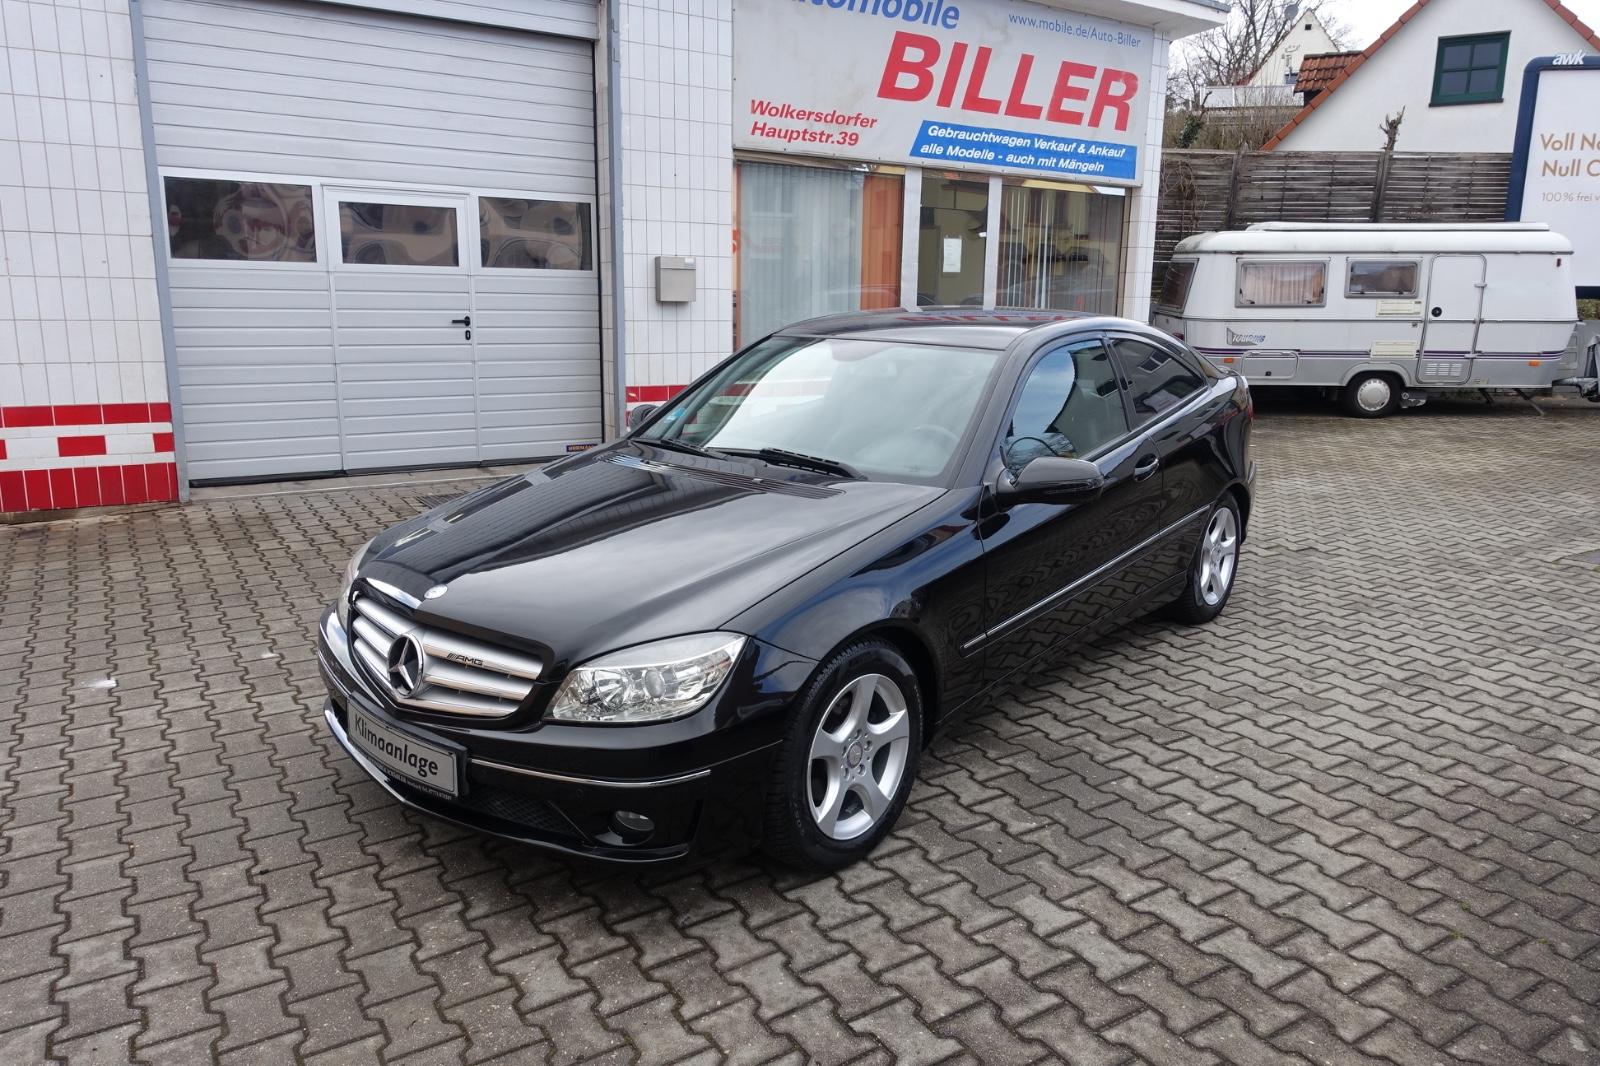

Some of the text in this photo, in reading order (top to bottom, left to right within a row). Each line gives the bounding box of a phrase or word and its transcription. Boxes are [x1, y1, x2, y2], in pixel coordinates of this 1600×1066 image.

[1008, 13, 1141, 48] www.mobile.de/Auto-Biller
[1552, 49, 1586, 66] awk
[877, 31, 1138, 131] BILLER
[751, 100, 877, 128] Wolkersdorfer
[751, 121, 859, 146] Hauptstr.39
[928, 125, 1126, 158] Gebrauchtwagen Verkauf & Ankauf
[1541, 132, 1600, 151] Voll N
[920, 143, 944, 154] alle
[946, 145, 995, 160] Modelle
[1006, 153, 1035, 165] auch
[1037, 157, 1057, 168] mit
[1058, 158, 1104, 172] Mängeln
[1542, 159, 1581, 177] Null
[1542, 192, 1574, 202] 100%
[1576, 192, 1592, 201] frei
[354, 713, 439, 778] Klimaanlage
